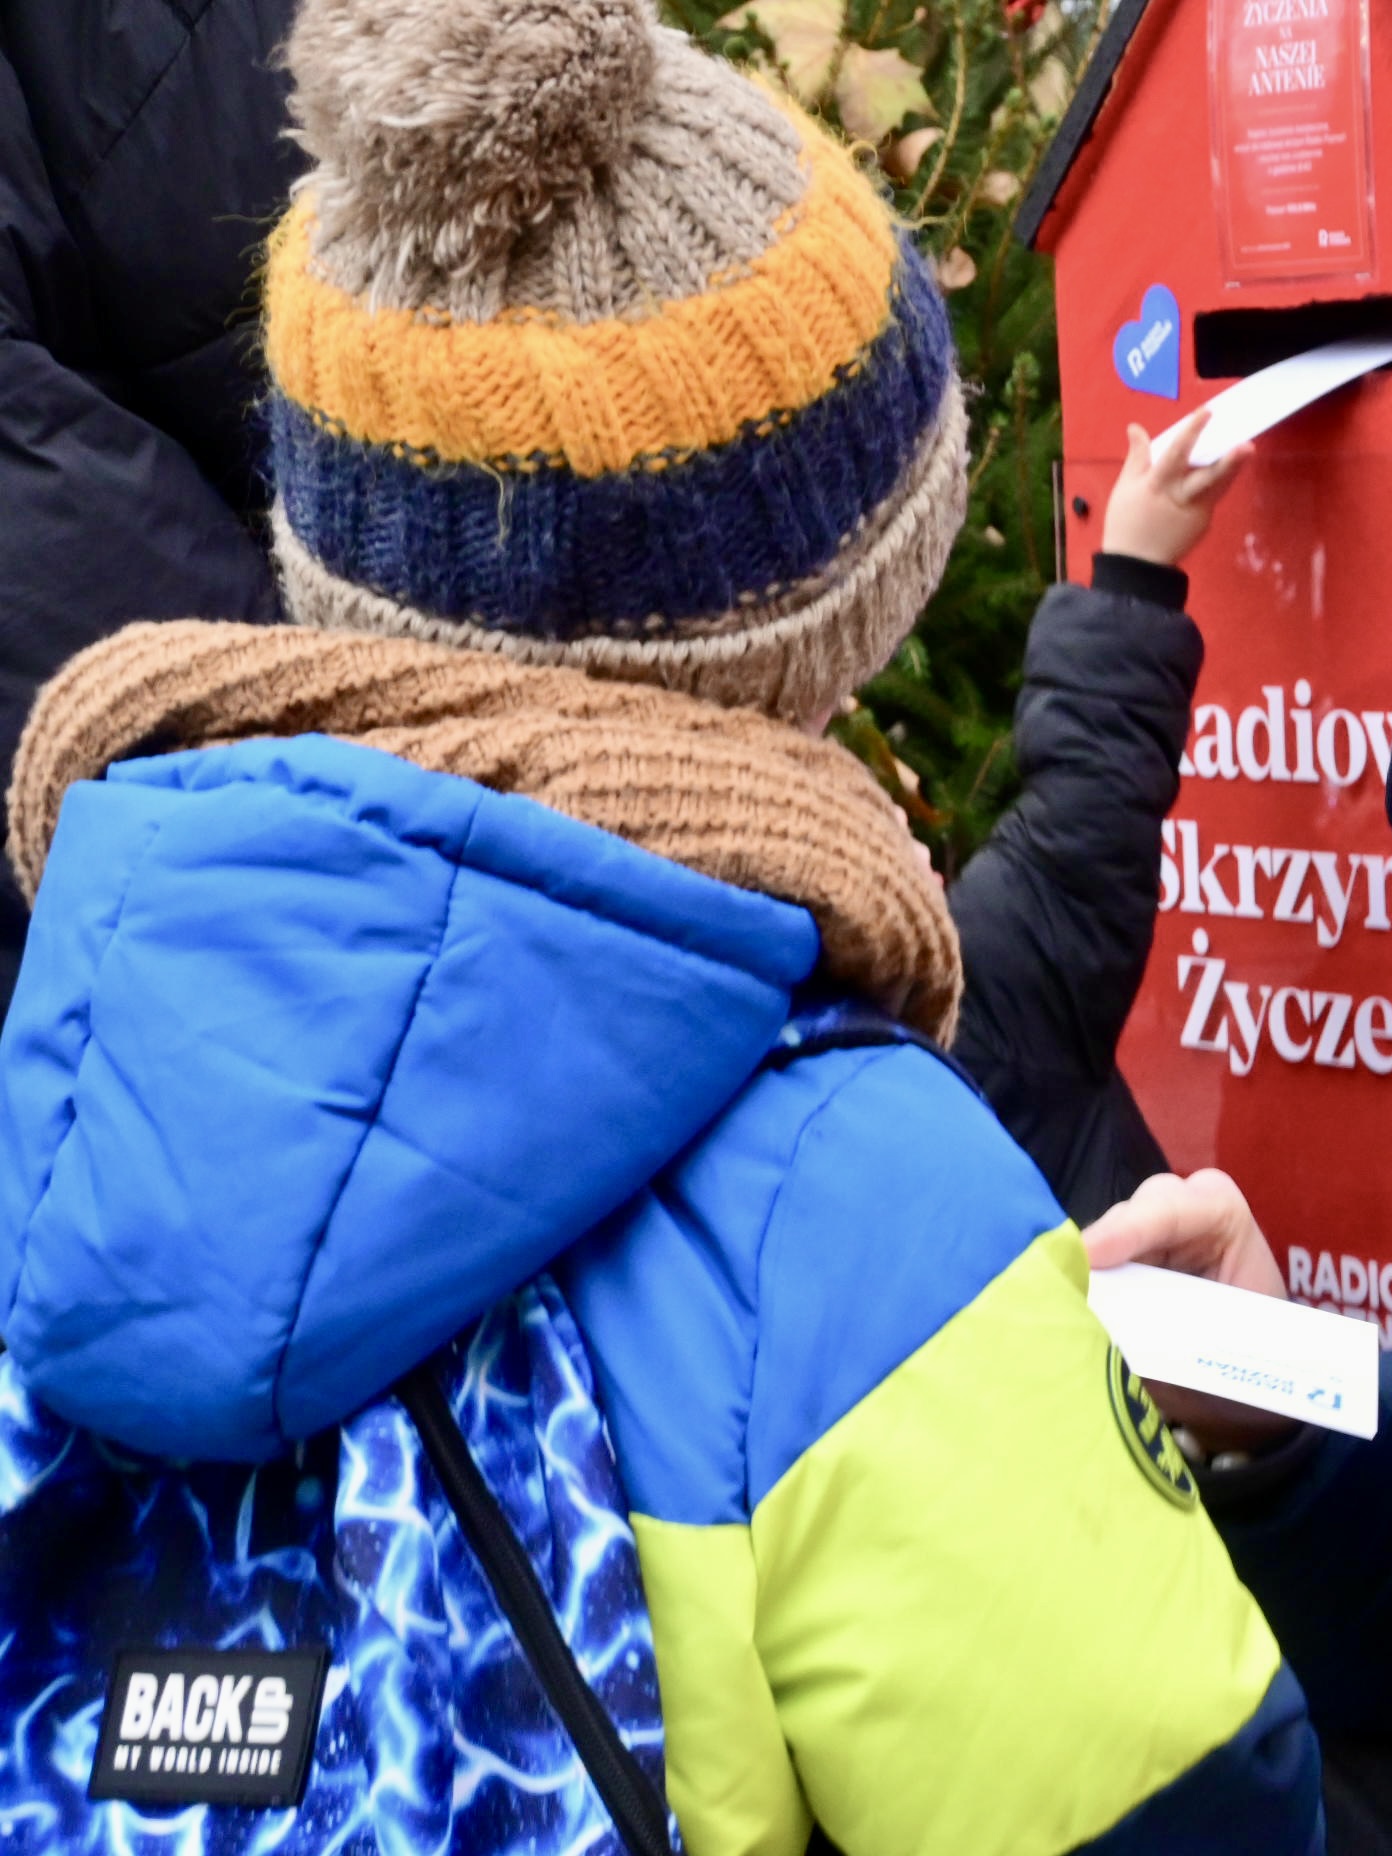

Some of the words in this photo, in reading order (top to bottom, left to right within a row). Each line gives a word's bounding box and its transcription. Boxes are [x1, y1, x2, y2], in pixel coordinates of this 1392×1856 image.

[114, 1744, 142, 1771] MY
[150, 1745, 212, 1774] WORLD
[218, 1748, 282, 1776] INSIDE
